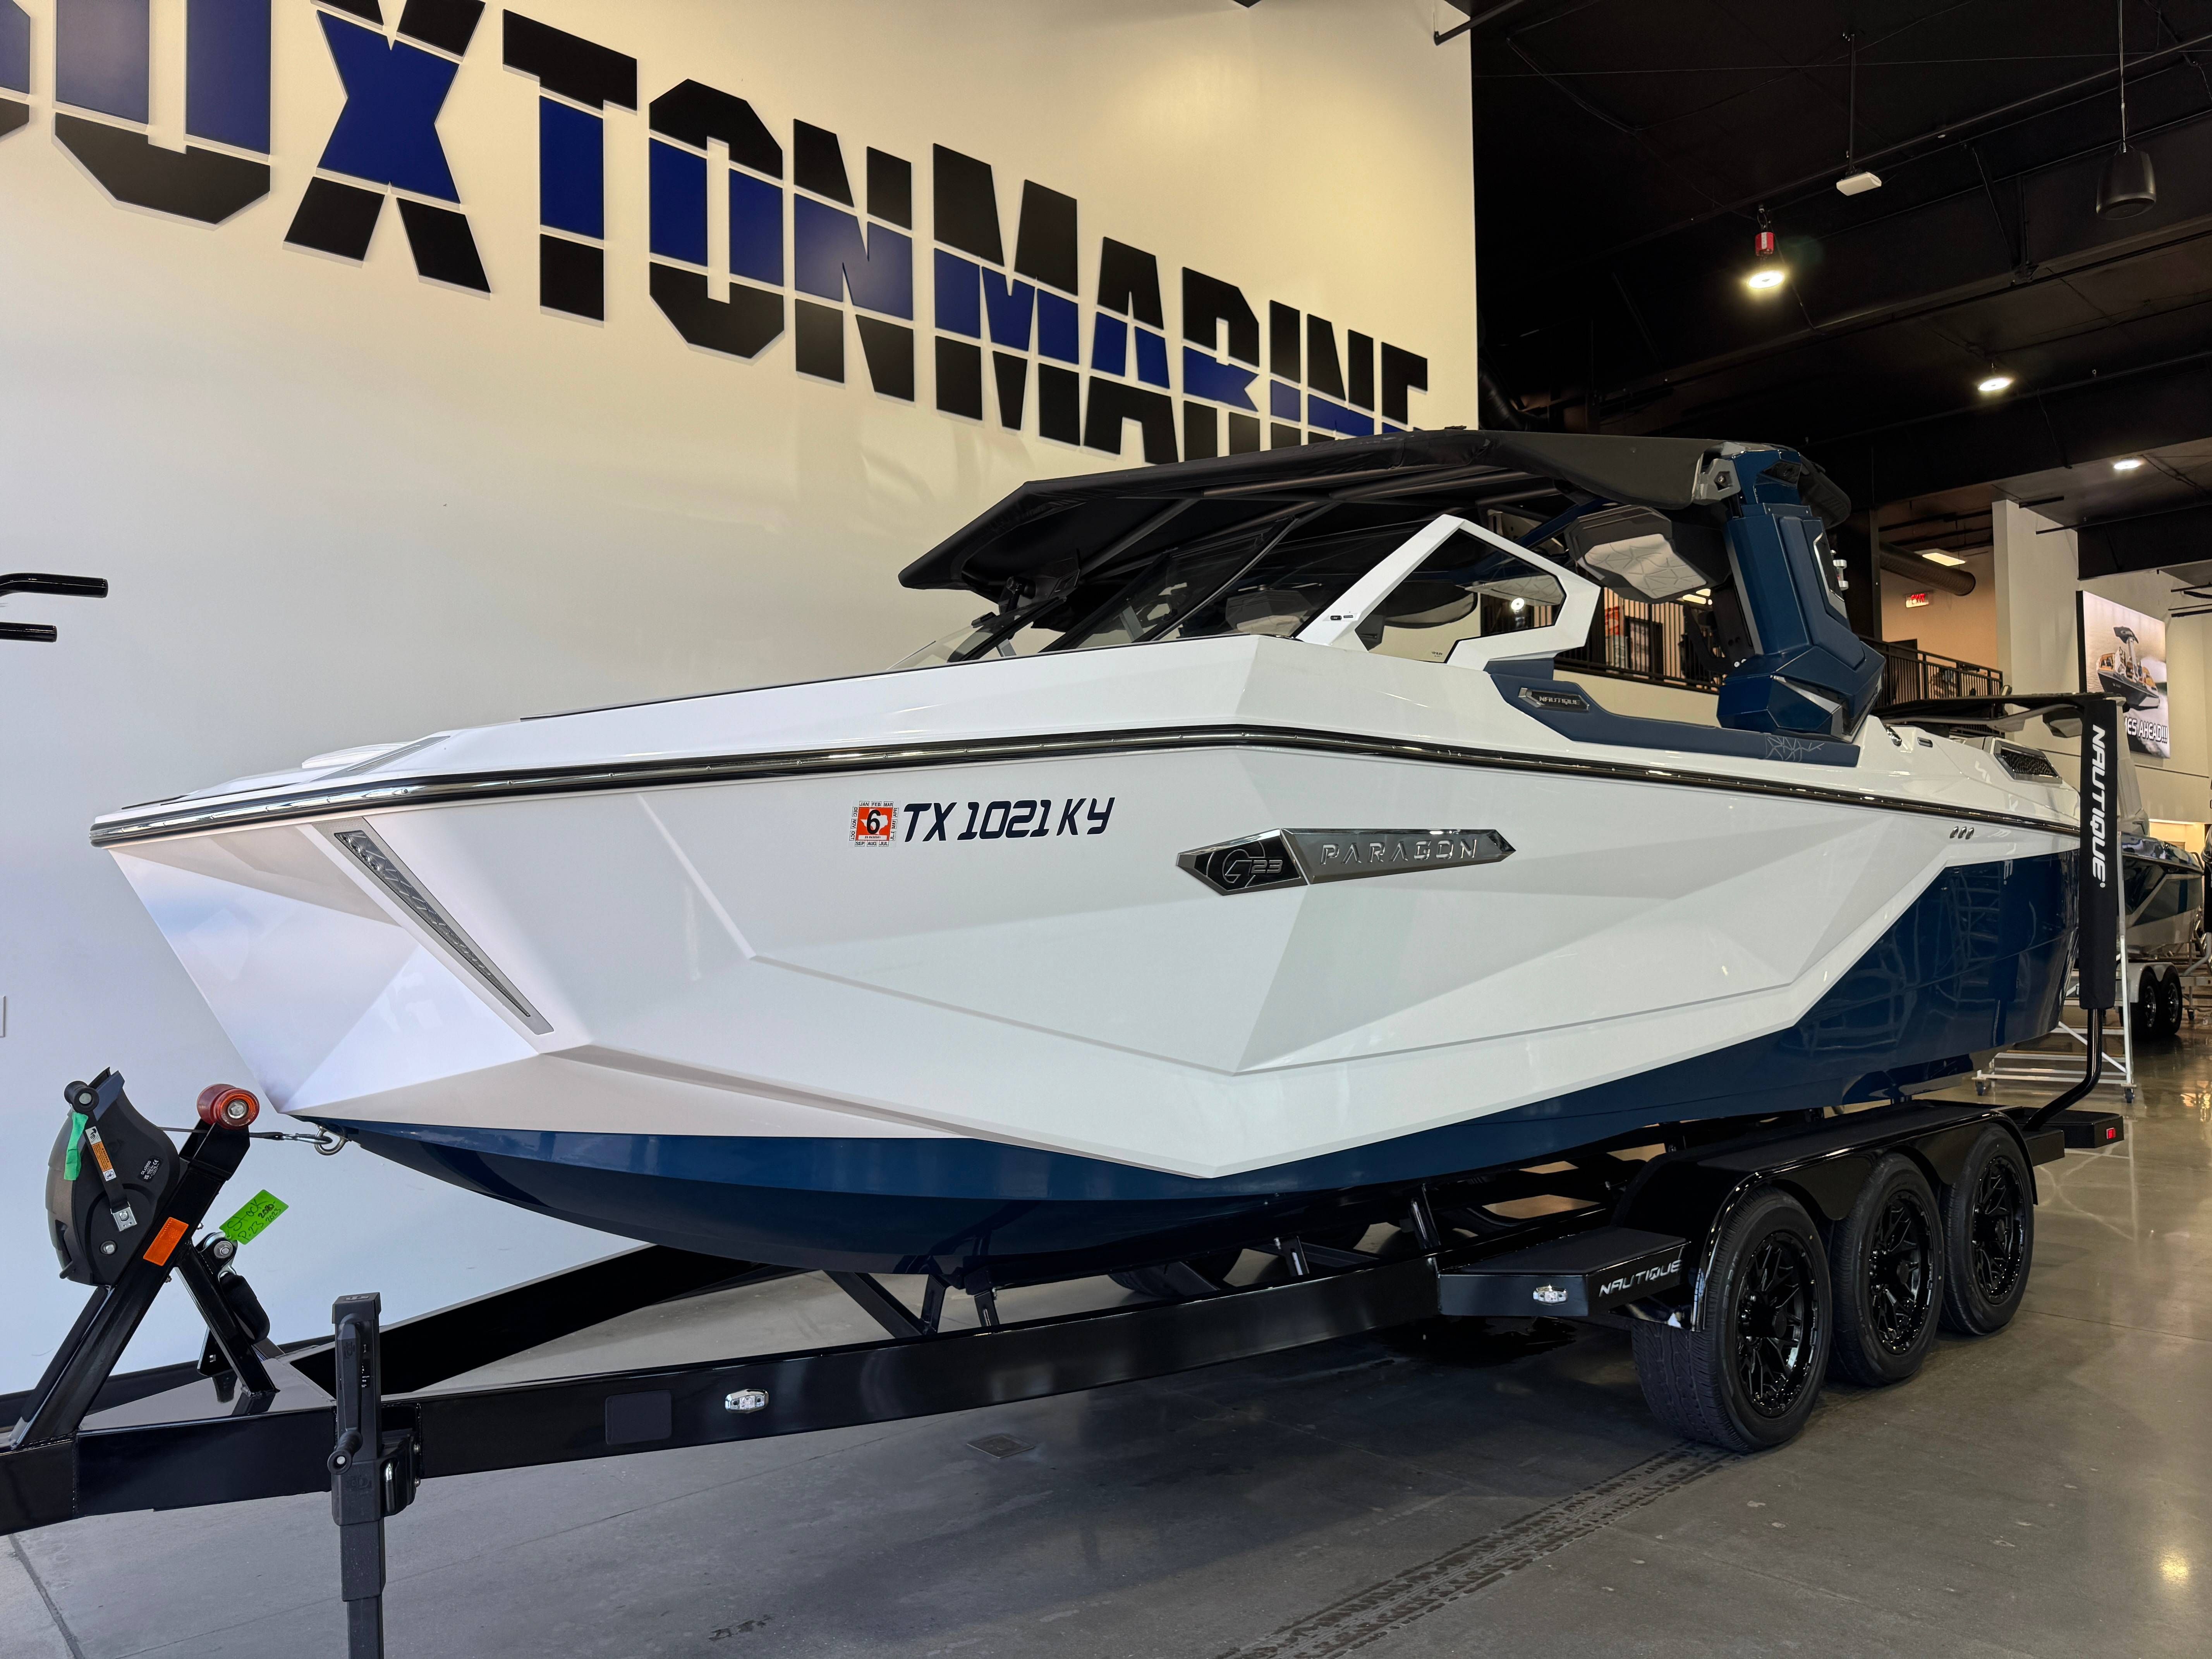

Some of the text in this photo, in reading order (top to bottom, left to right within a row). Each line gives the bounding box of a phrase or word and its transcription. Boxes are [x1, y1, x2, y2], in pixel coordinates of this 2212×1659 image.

[2138, 721, 2167, 743] AHEAD!!!
[867, 810, 881, 834] 6
[904, 797, 1115, 842] TX 1021 KY
[1319, 838, 1478, 866] PARAGON
[1599, 1259, 1683, 1297] NAUTIQUE
